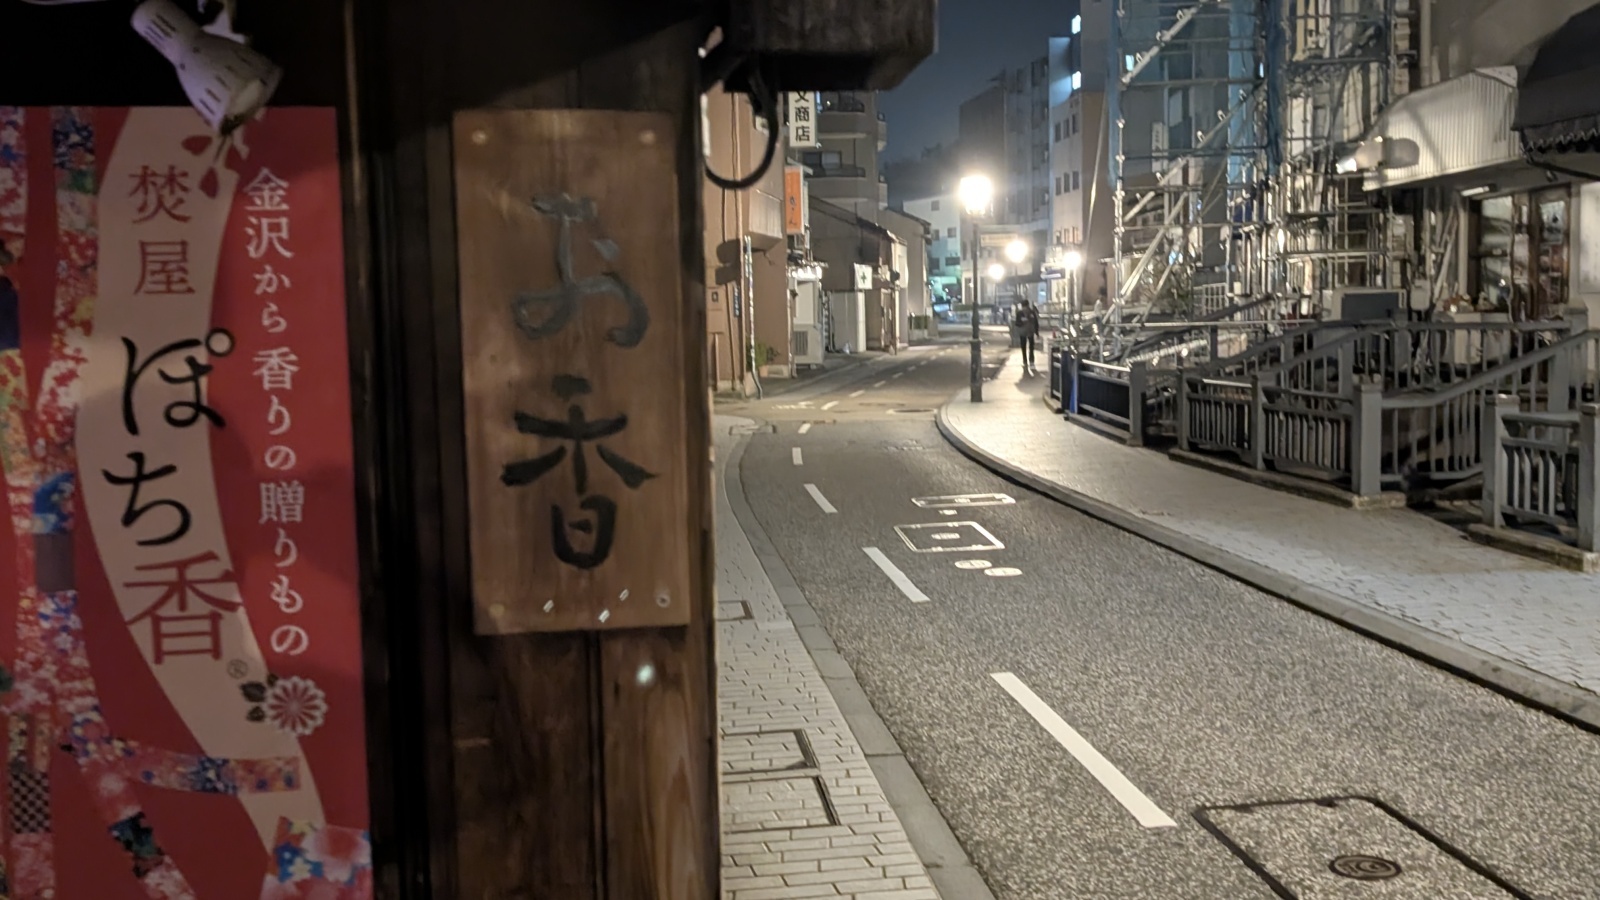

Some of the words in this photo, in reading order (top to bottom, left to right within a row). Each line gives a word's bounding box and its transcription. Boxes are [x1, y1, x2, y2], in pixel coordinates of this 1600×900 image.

[128, 164, 196, 296] 焚屋
[501, 193, 659, 569] お香
[102, 327, 244, 665] ぽち香
[243, 165, 309, 656] 金沢から香りの贈りもの
